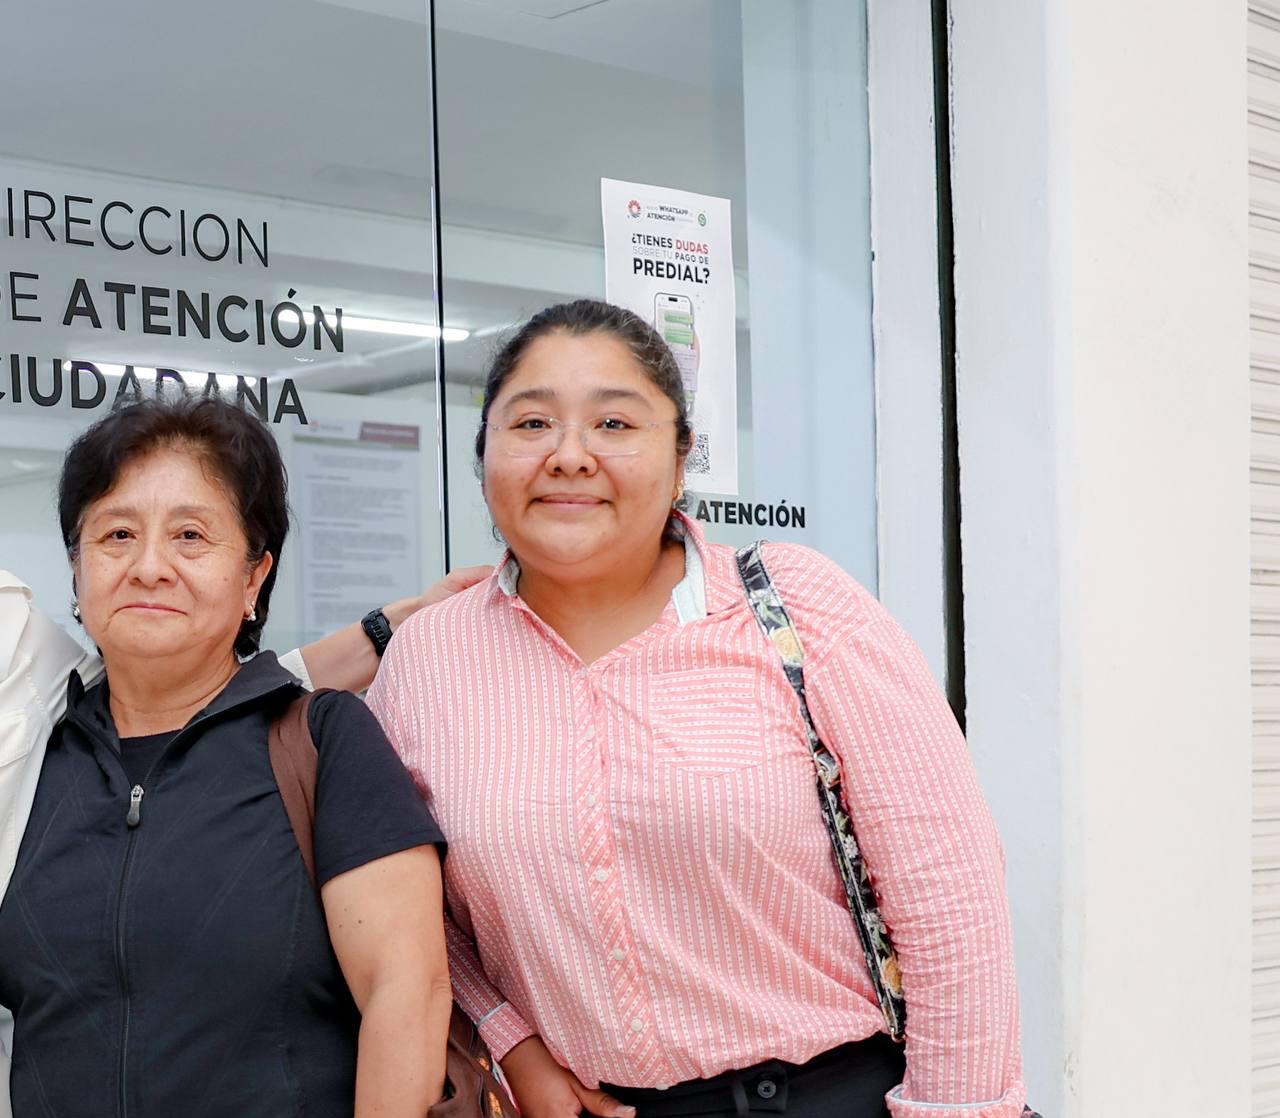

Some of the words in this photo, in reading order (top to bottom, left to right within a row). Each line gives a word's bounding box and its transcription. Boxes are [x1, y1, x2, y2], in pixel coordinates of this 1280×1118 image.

[631, 233, 673, 249] ¿TIENES
[675, 239, 709, 255] DUDAS
[632, 246, 660, 258] SOBRE
[662, 250, 673, 260] TU
[675, 252, 697, 263] PAGO
[698, 256, 709, 265] DE
[632, 257, 710, 285] PREDIAL?
[62, 278, 345, 353] ATENCIÓN
[695, 499, 806, 529] ATENCIÓN
